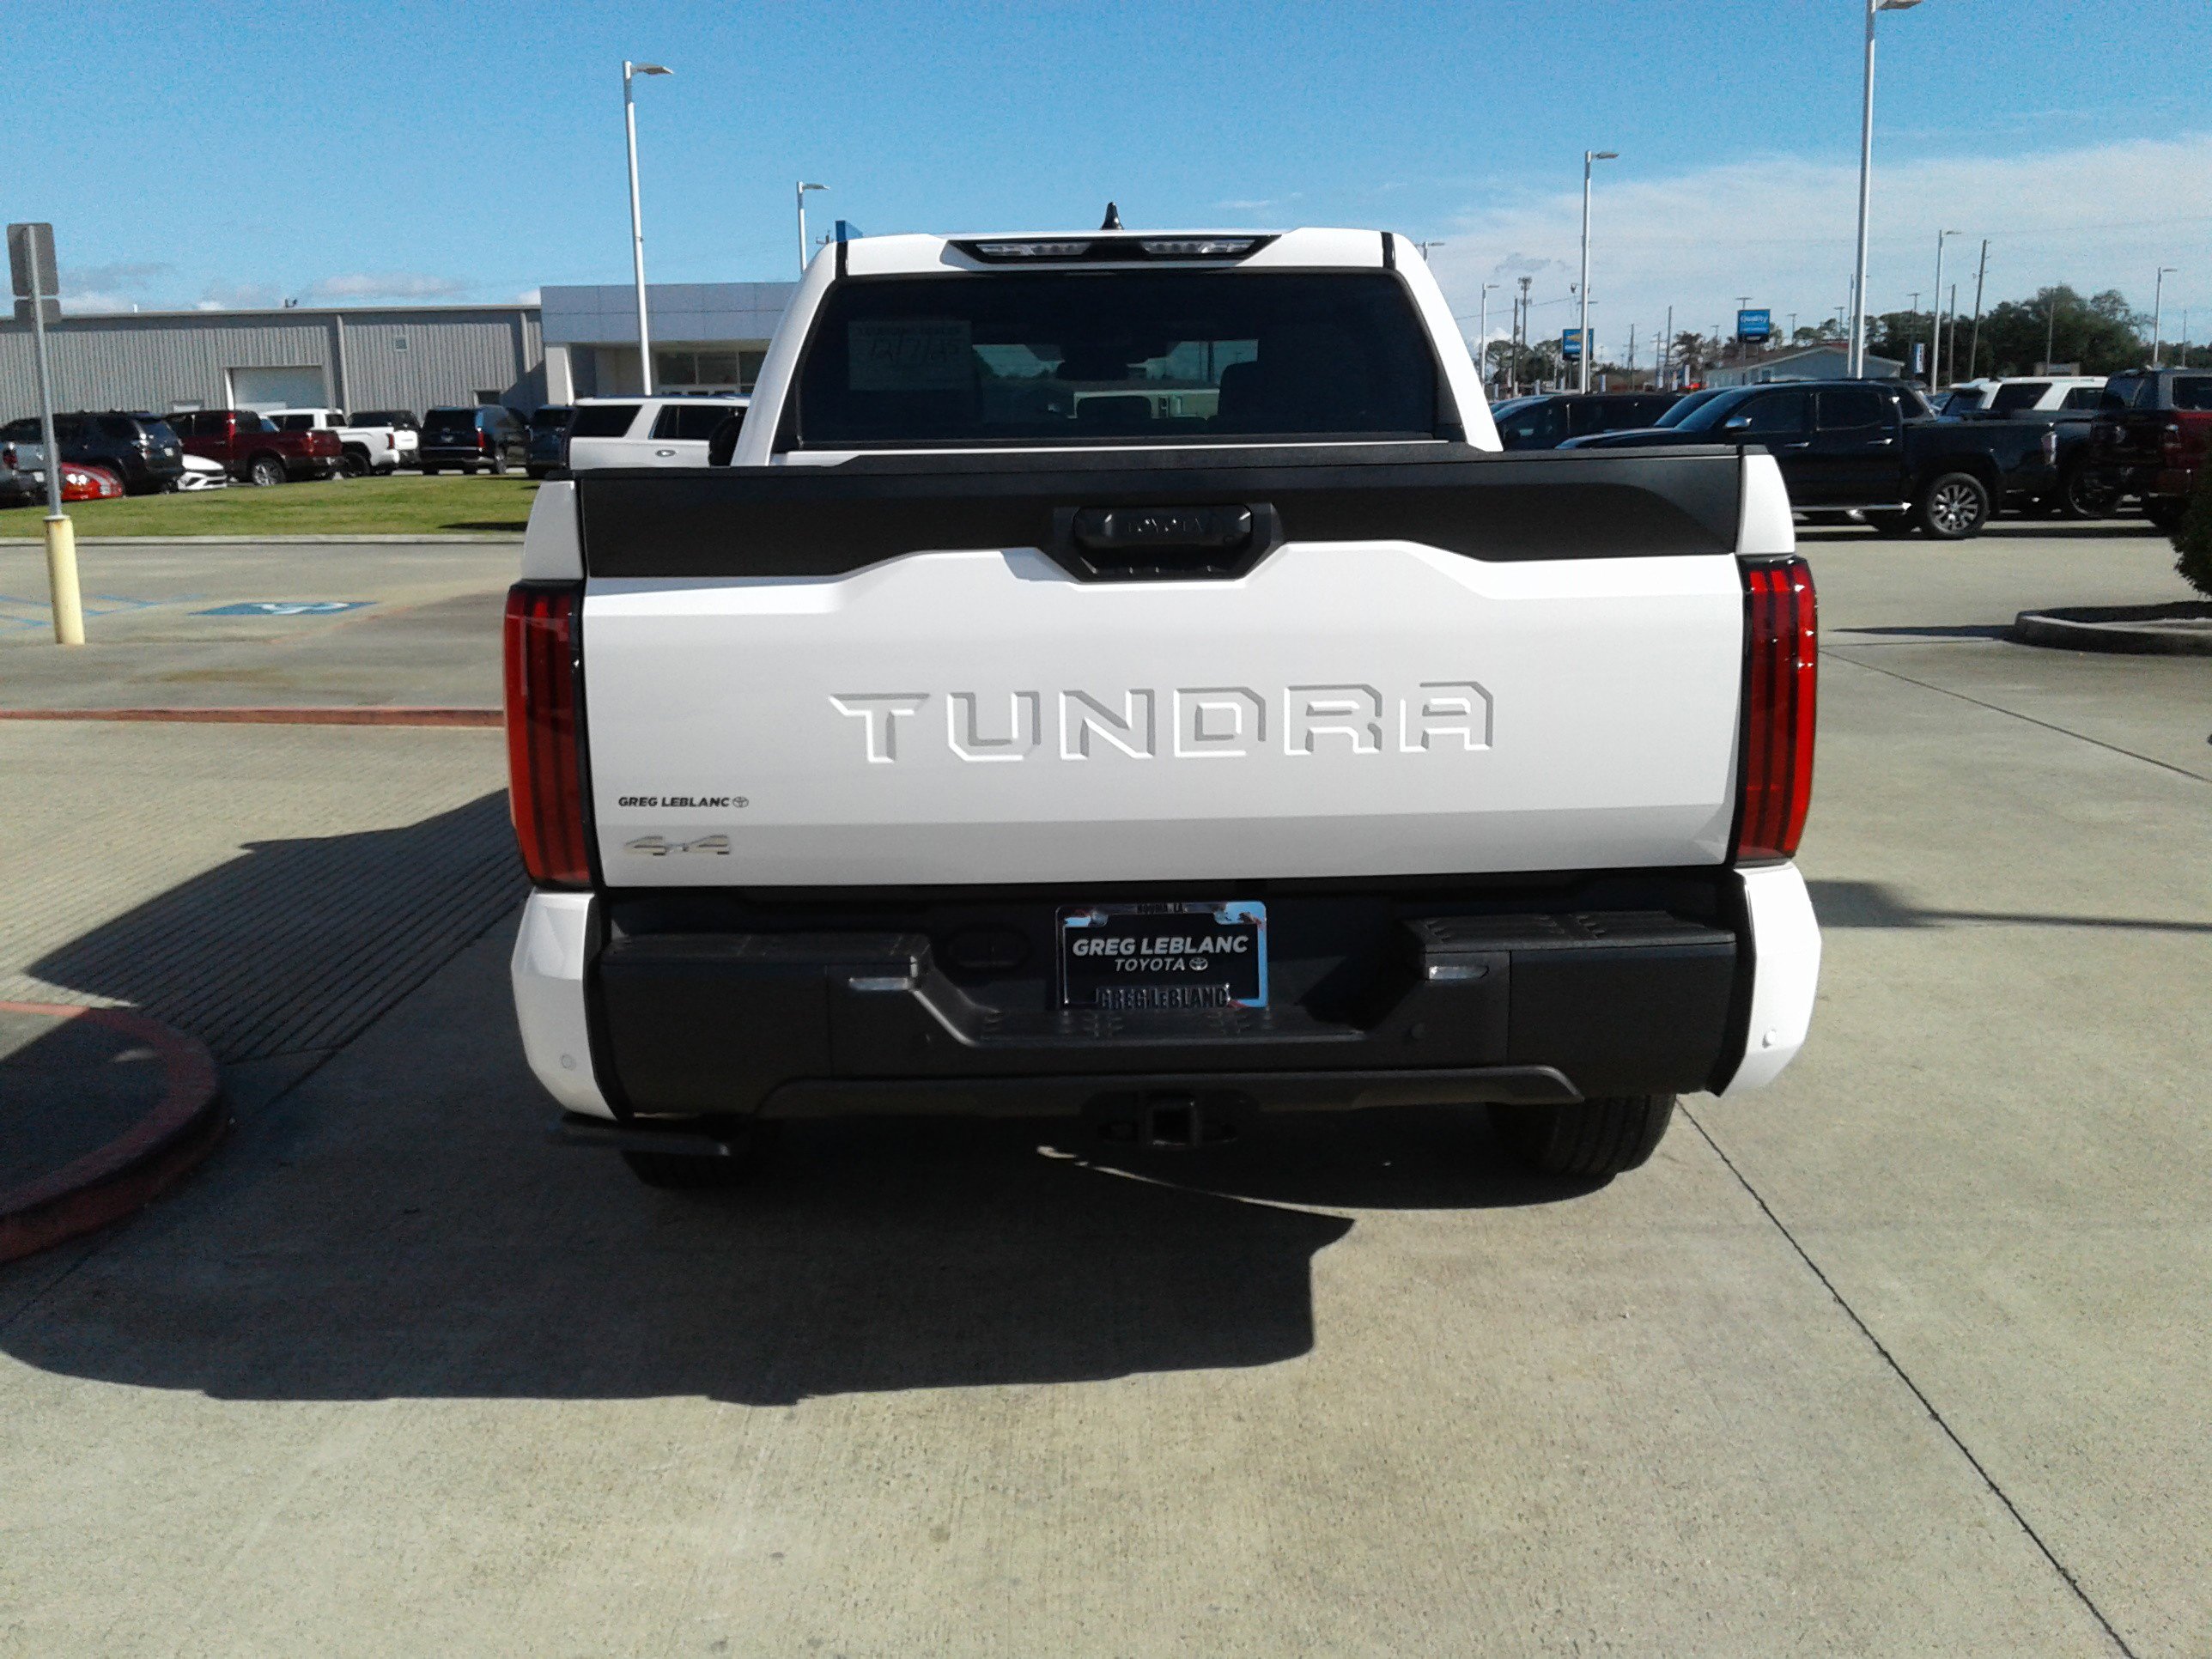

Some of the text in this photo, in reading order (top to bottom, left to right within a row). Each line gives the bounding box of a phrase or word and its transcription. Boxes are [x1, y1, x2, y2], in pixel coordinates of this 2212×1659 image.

[830, 681, 1493, 762] TUNDRA
[618, 796, 730, 807] GREG LEBLANC
[1073, 935, 1249, 957] GREG LEBLANC
[1115, 957, 1185, 972] TOYOTA
